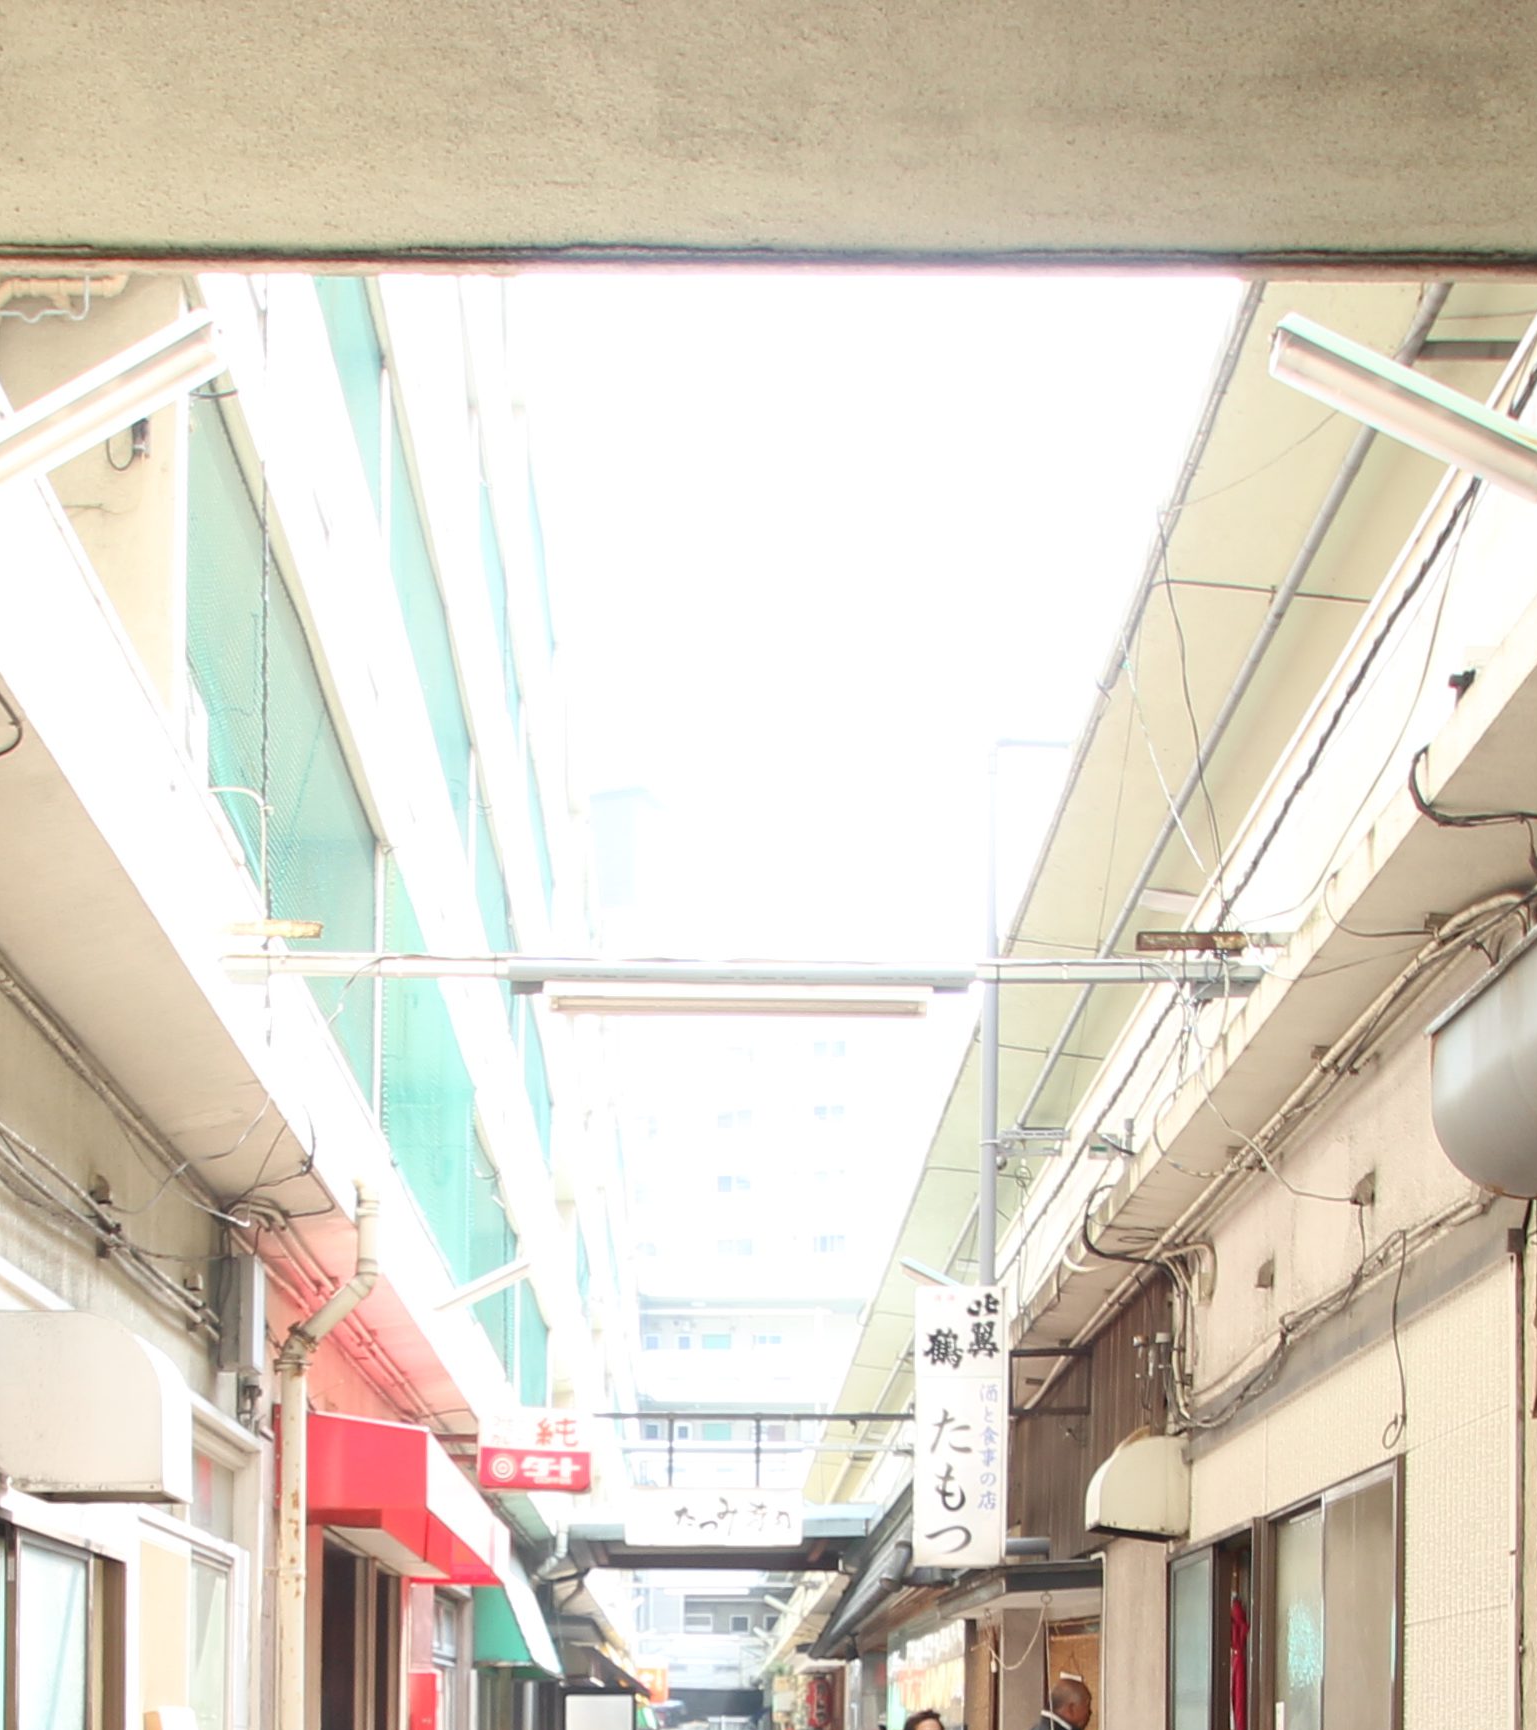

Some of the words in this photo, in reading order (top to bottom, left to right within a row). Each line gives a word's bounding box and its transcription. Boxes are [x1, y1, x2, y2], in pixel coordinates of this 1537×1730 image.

[535, 1417, 580, 1447] 純
[925, 1408, 972, 1554] たもつ
[978, 1384, 999, 1511] 酒と食事の店
